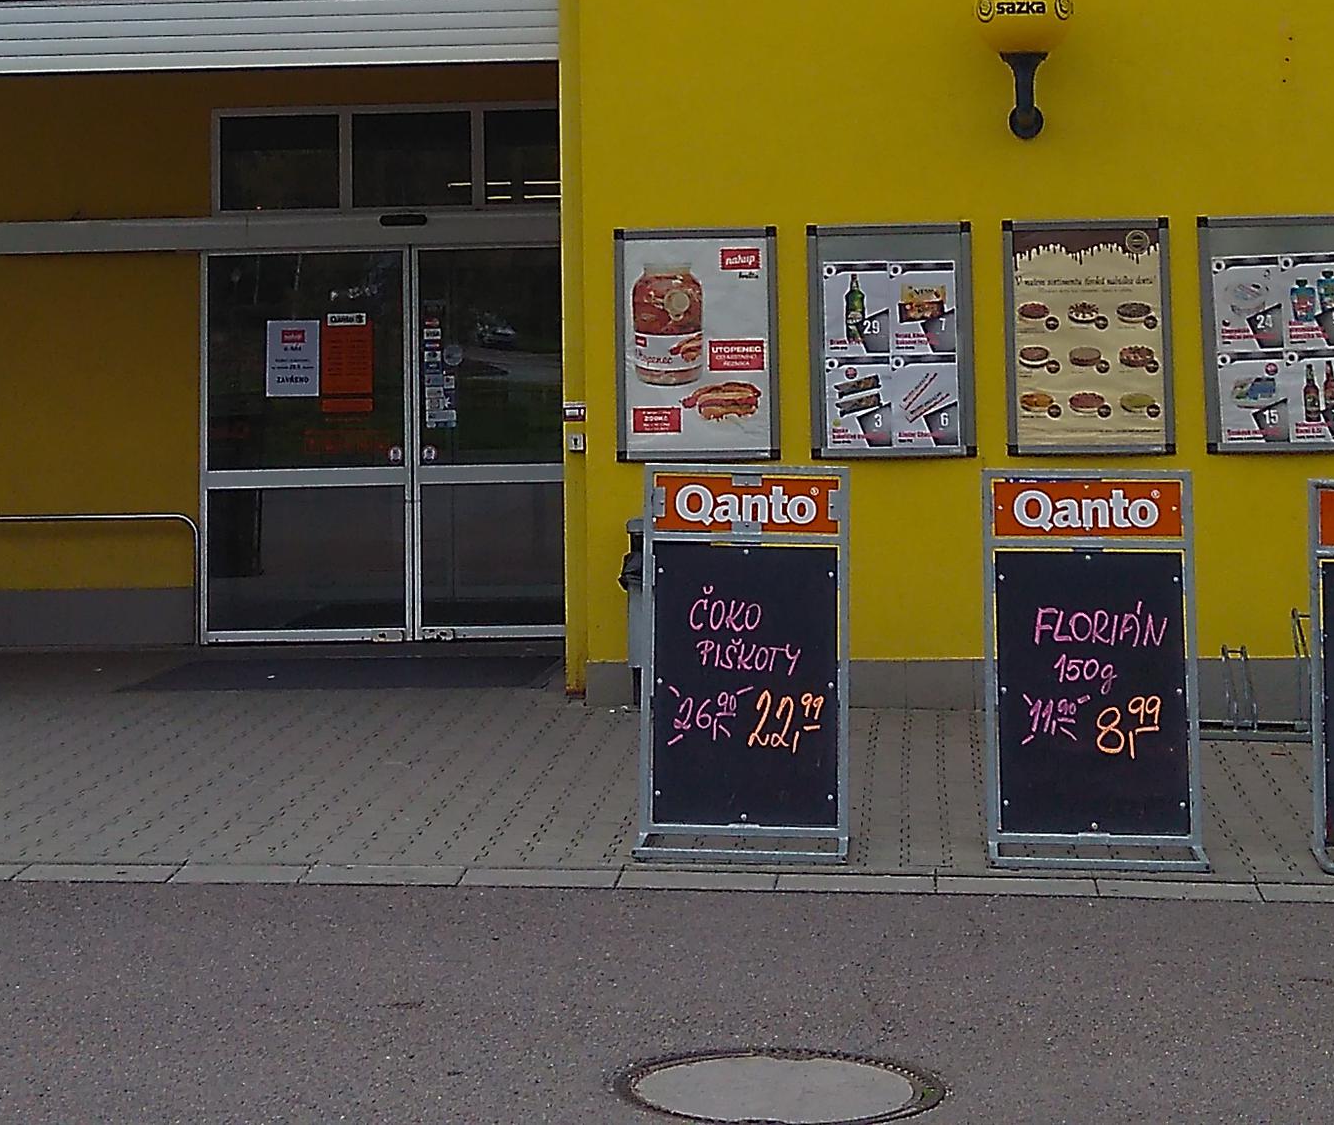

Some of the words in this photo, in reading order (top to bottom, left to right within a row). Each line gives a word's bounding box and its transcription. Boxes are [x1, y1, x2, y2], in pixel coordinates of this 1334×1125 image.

[996, 1, 1046, 15] sazka
[863, 320, 881, 334] 29
[874, 414, 883, 428] 3
[940, 412, 949, 427] 6
[1263, 409, 1279, 424] 15
[675, 483, 818, 525] Qanto
[1013, 490, 1160, 531] Qanto
[689, 585, 763, 632] ČOKO
[1034, 600, 1169, 647] FLORIÁN
[696, 638, 802, 676] PIŠKOTY
[1054, 653, 1118, 695] 150g
